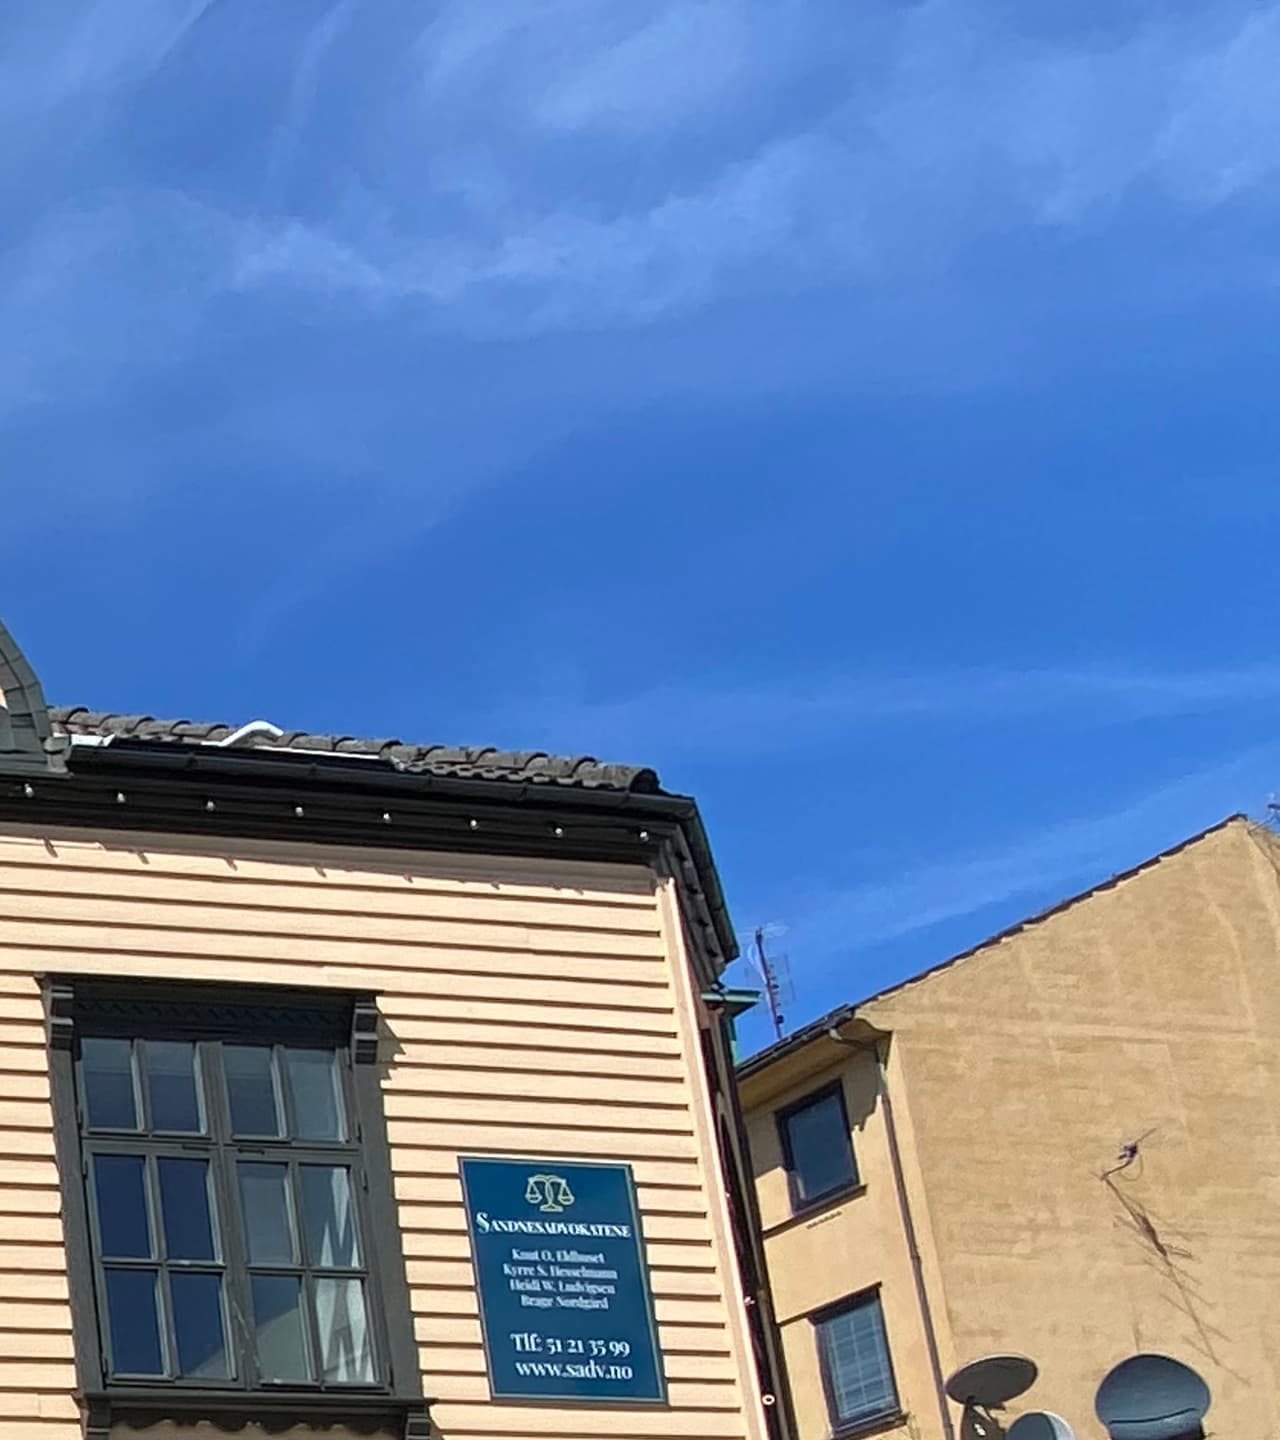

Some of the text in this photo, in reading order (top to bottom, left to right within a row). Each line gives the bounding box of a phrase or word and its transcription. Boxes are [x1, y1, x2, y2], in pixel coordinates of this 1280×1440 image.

[546, 1338, 563, 1354] 51
[567, 1339, 584, 1354] 21
[589, 1340, 606, 1357] 35
[609, 1340, 630, 1358] 99
[515, 1359, 633, 1380] www.sadv.no
